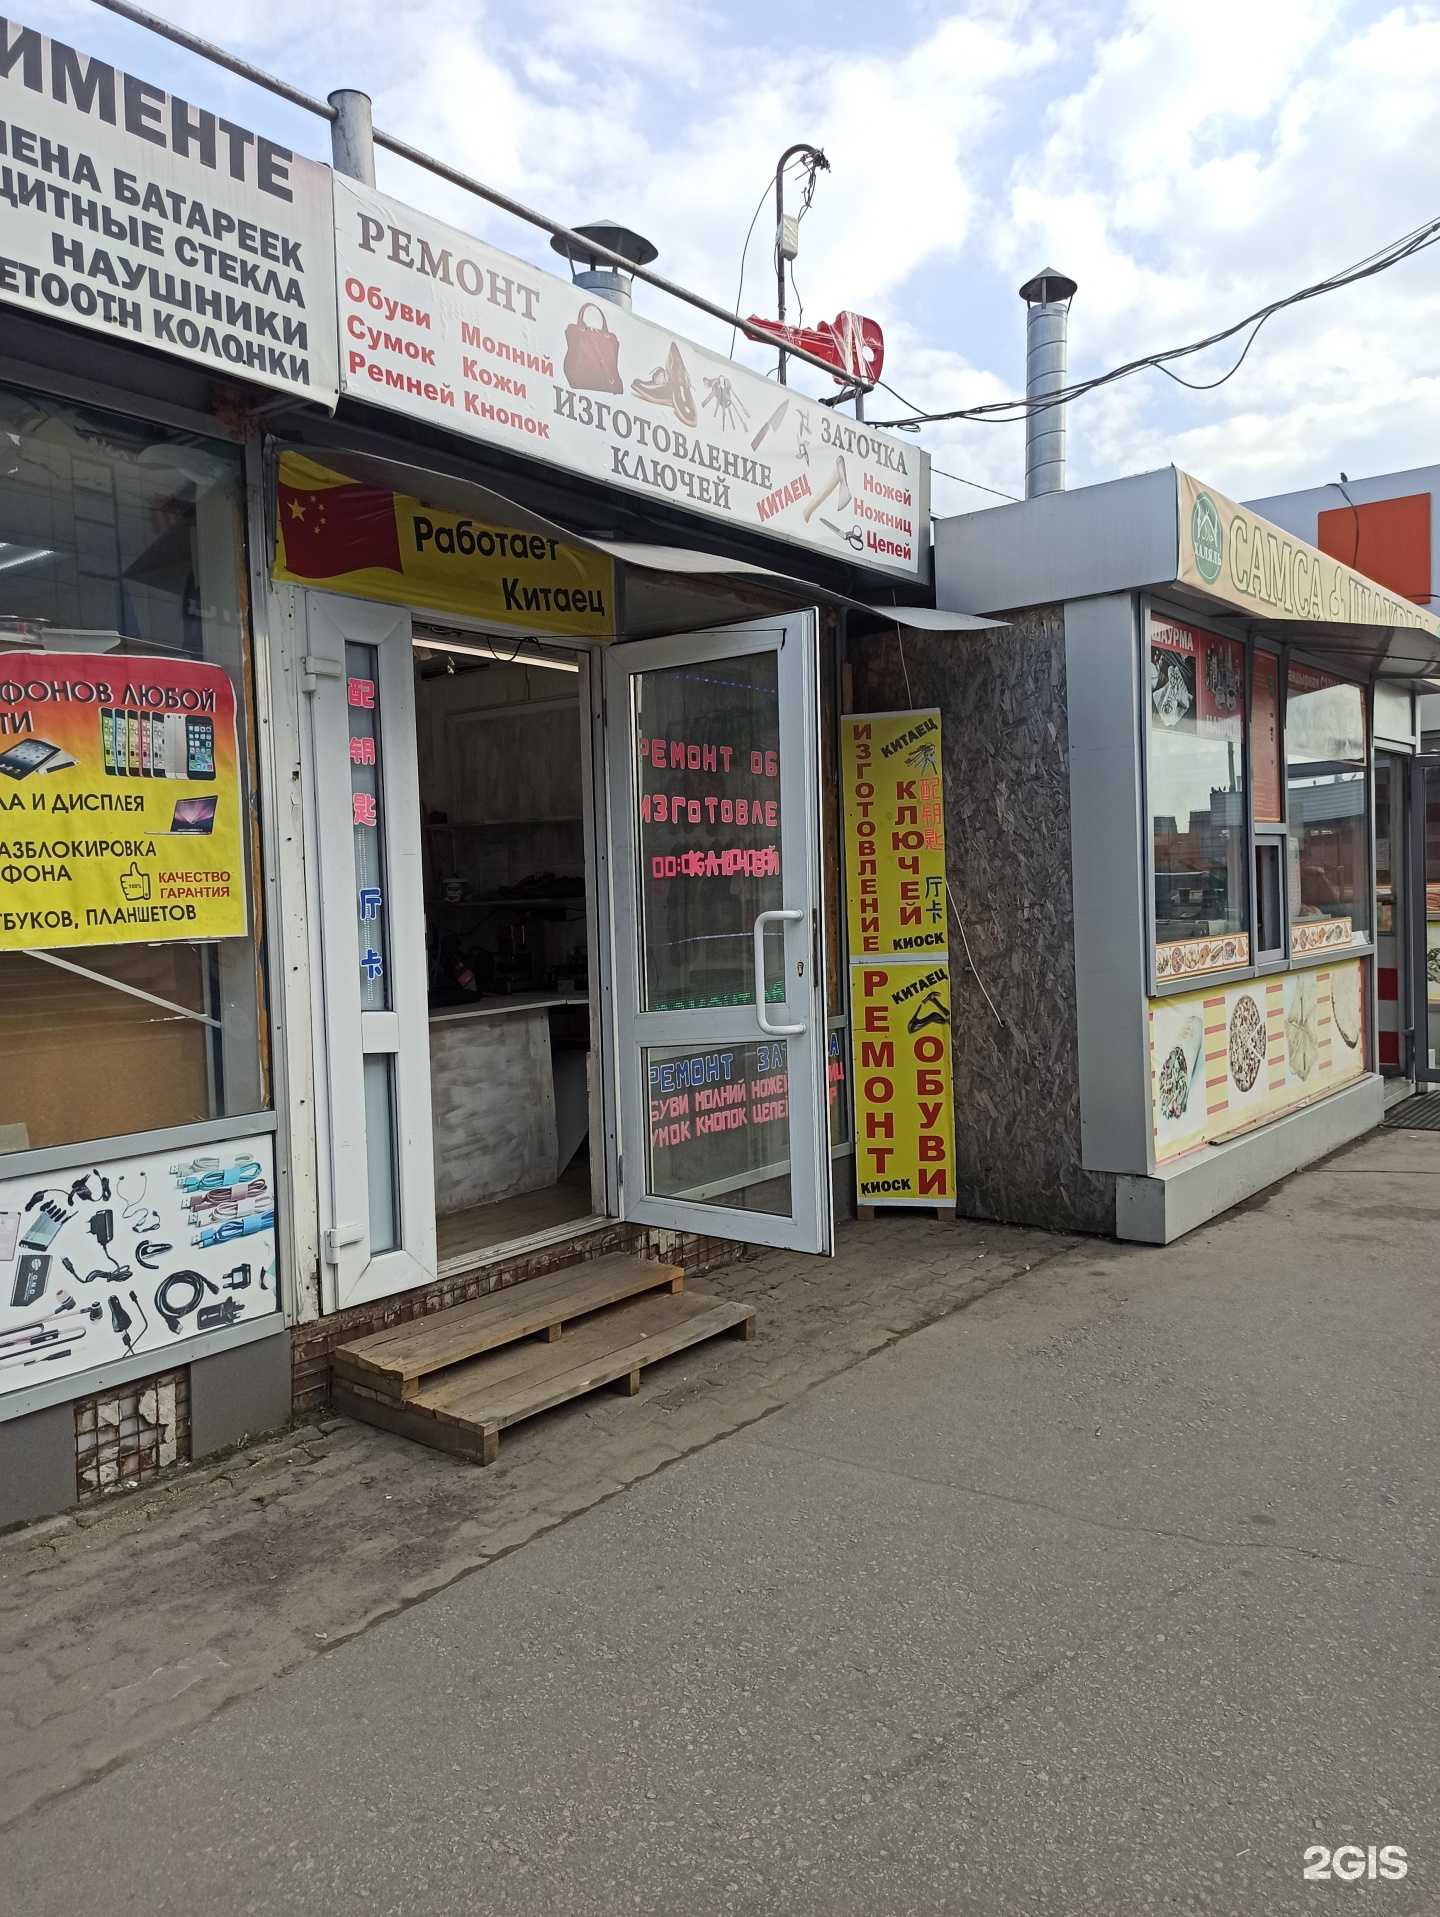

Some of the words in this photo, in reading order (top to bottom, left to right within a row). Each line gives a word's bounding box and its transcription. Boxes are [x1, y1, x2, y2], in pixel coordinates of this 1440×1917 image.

[0, 15, 293, 203] ИМЕНТЕ
[0, 120, 102, 193] ЕНА
[114, 167, 305, 273] БАТАРЕЕК
[174, 235, 306, 309] СТЕКЛА
[357, 211, 540, 322] РЕМОНТ
[52, 232, 308, 351] НАУШНИКИ
[345, 277, 431, 329] Обуви
[153, 309, 310, 386] КОЛОНКИ
[347, 314, 436, 366] Сумок
[461, 321, 554, 377] Молний
[349, 350, 455, 407] Ремней
[463, 356, 527, 399] Кожи
[464, 390, 550, 440] Кнопок
[553, 385, 773, 490] ИЗГОТОВЛЕНИЕ
[820, 417, 909, 476] ЗАТОЧКА
[610, 445, 731, 510] КЛЮЧЕЙ
[756, 473, 812, 522] КИТАЕЦ
[863, 473, 912, 507] Ножей
[412, 515, 560, 561] Работает
[853, 499, 912, 537] Ножниц
[866, 529, 912, 561] Цепей
[1229, 515, 1322, 620] САМСА
[501, 577, 605, 616] Китаец
[1, 679, 114, 706] ФОНОВ
[122, 682, 216, 713] ЛЮБОЙ
[881, 718, 938, 758] КИТАЕЦ
[32, 793, 46, 811] И
[51, 794, 144, 814] ДИСПЛЕЯ
[853, 724, 880, 952] ИЗГОТОВЛЕНИЕ
[892, 780, 925, 926] КЛЮЧЕЙ
[1, 864, 72, 884] ФОНА
[158, 871, 230, 883] КАЧЕСТВО
[160, 886, 230, 898] ГАРАНТИЯ
[0, 909, 79, 931] БУКОВ,
[86, 905, 197, 926] ПЛАНШЕТОВ
[893, 932, 945, 950] КИОСК
[891, 968, 948, 1004] КИТАЕЦ
[649, 1053, 734, 1093] РЕМОНТ
[861, 970, 896, 1175] РЕМОНТ
[696, 1108, 748, 1136] КНОПОК
[913, 1035, 947, 1195] ОБУВИ
[860, 1178, 911, 1194] КИОСК
